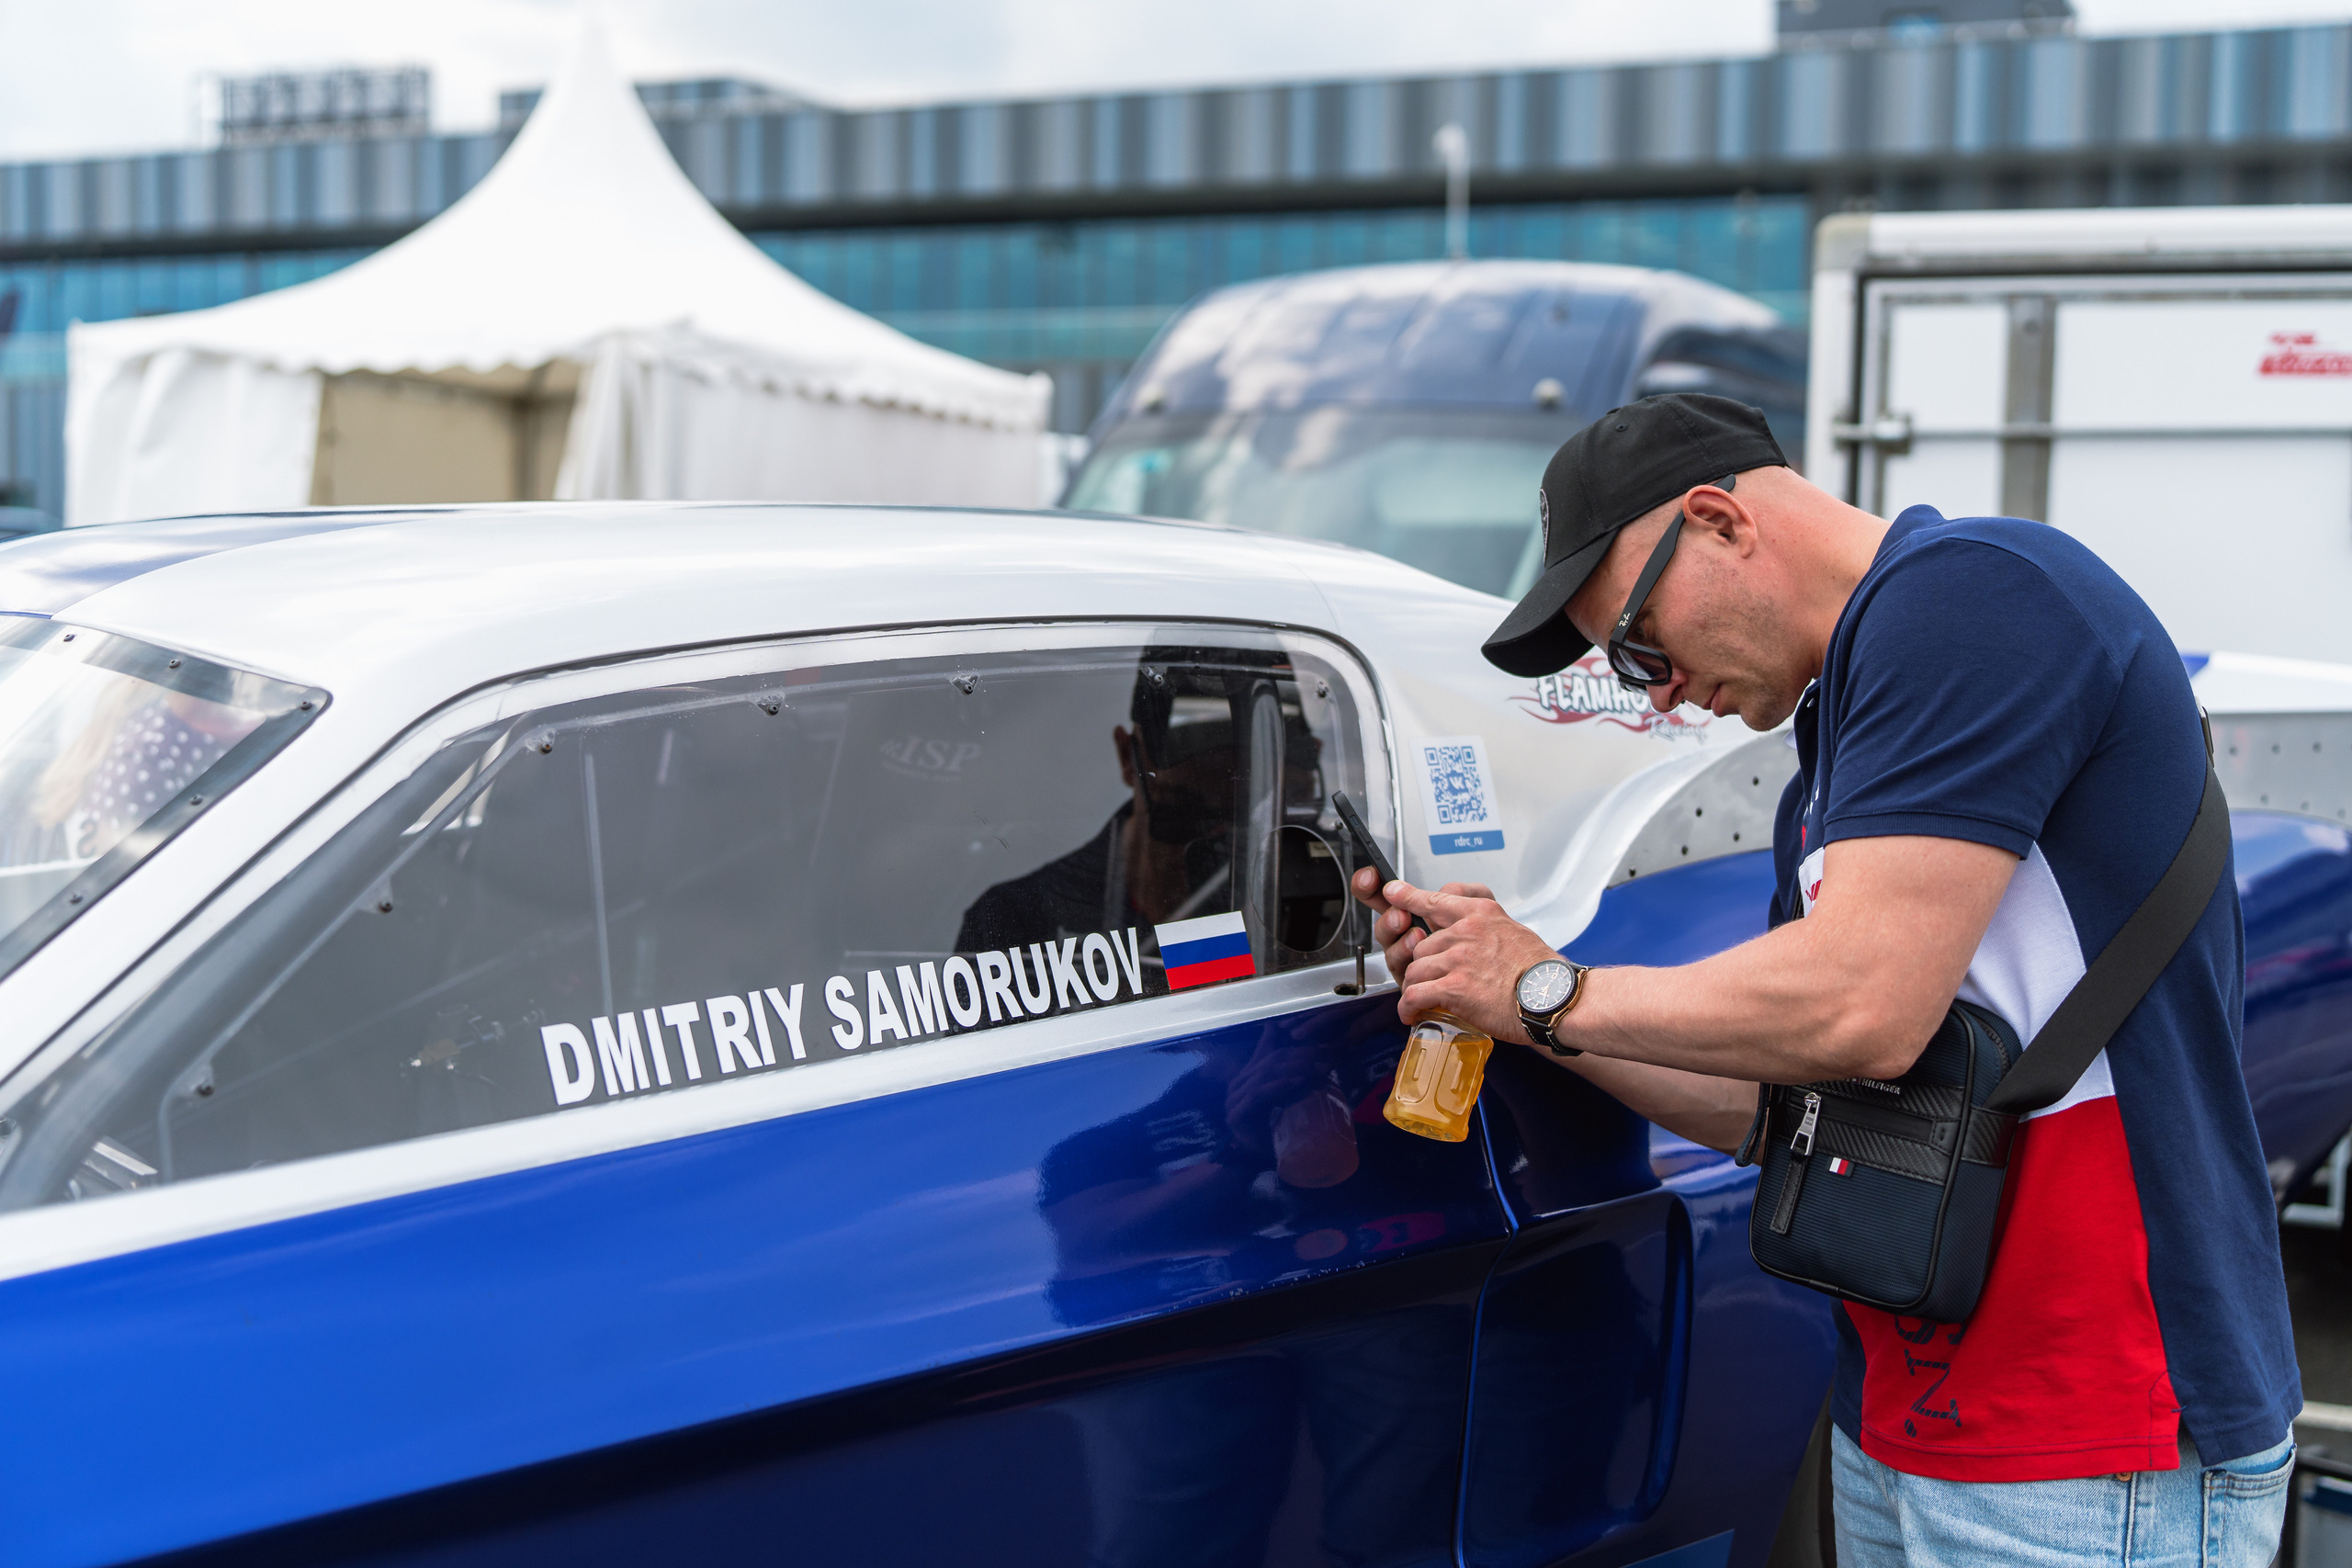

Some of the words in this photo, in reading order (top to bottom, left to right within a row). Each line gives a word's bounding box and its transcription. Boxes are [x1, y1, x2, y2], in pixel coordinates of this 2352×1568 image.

[1453, 836, 1484, 848] rdrc_ru
[540, 983, 805, 1106] DMITRIY
[824, 926, 1143, 1051] SAMORUKOV
[1861, 1077, 1901, 1095] HILFIGER
